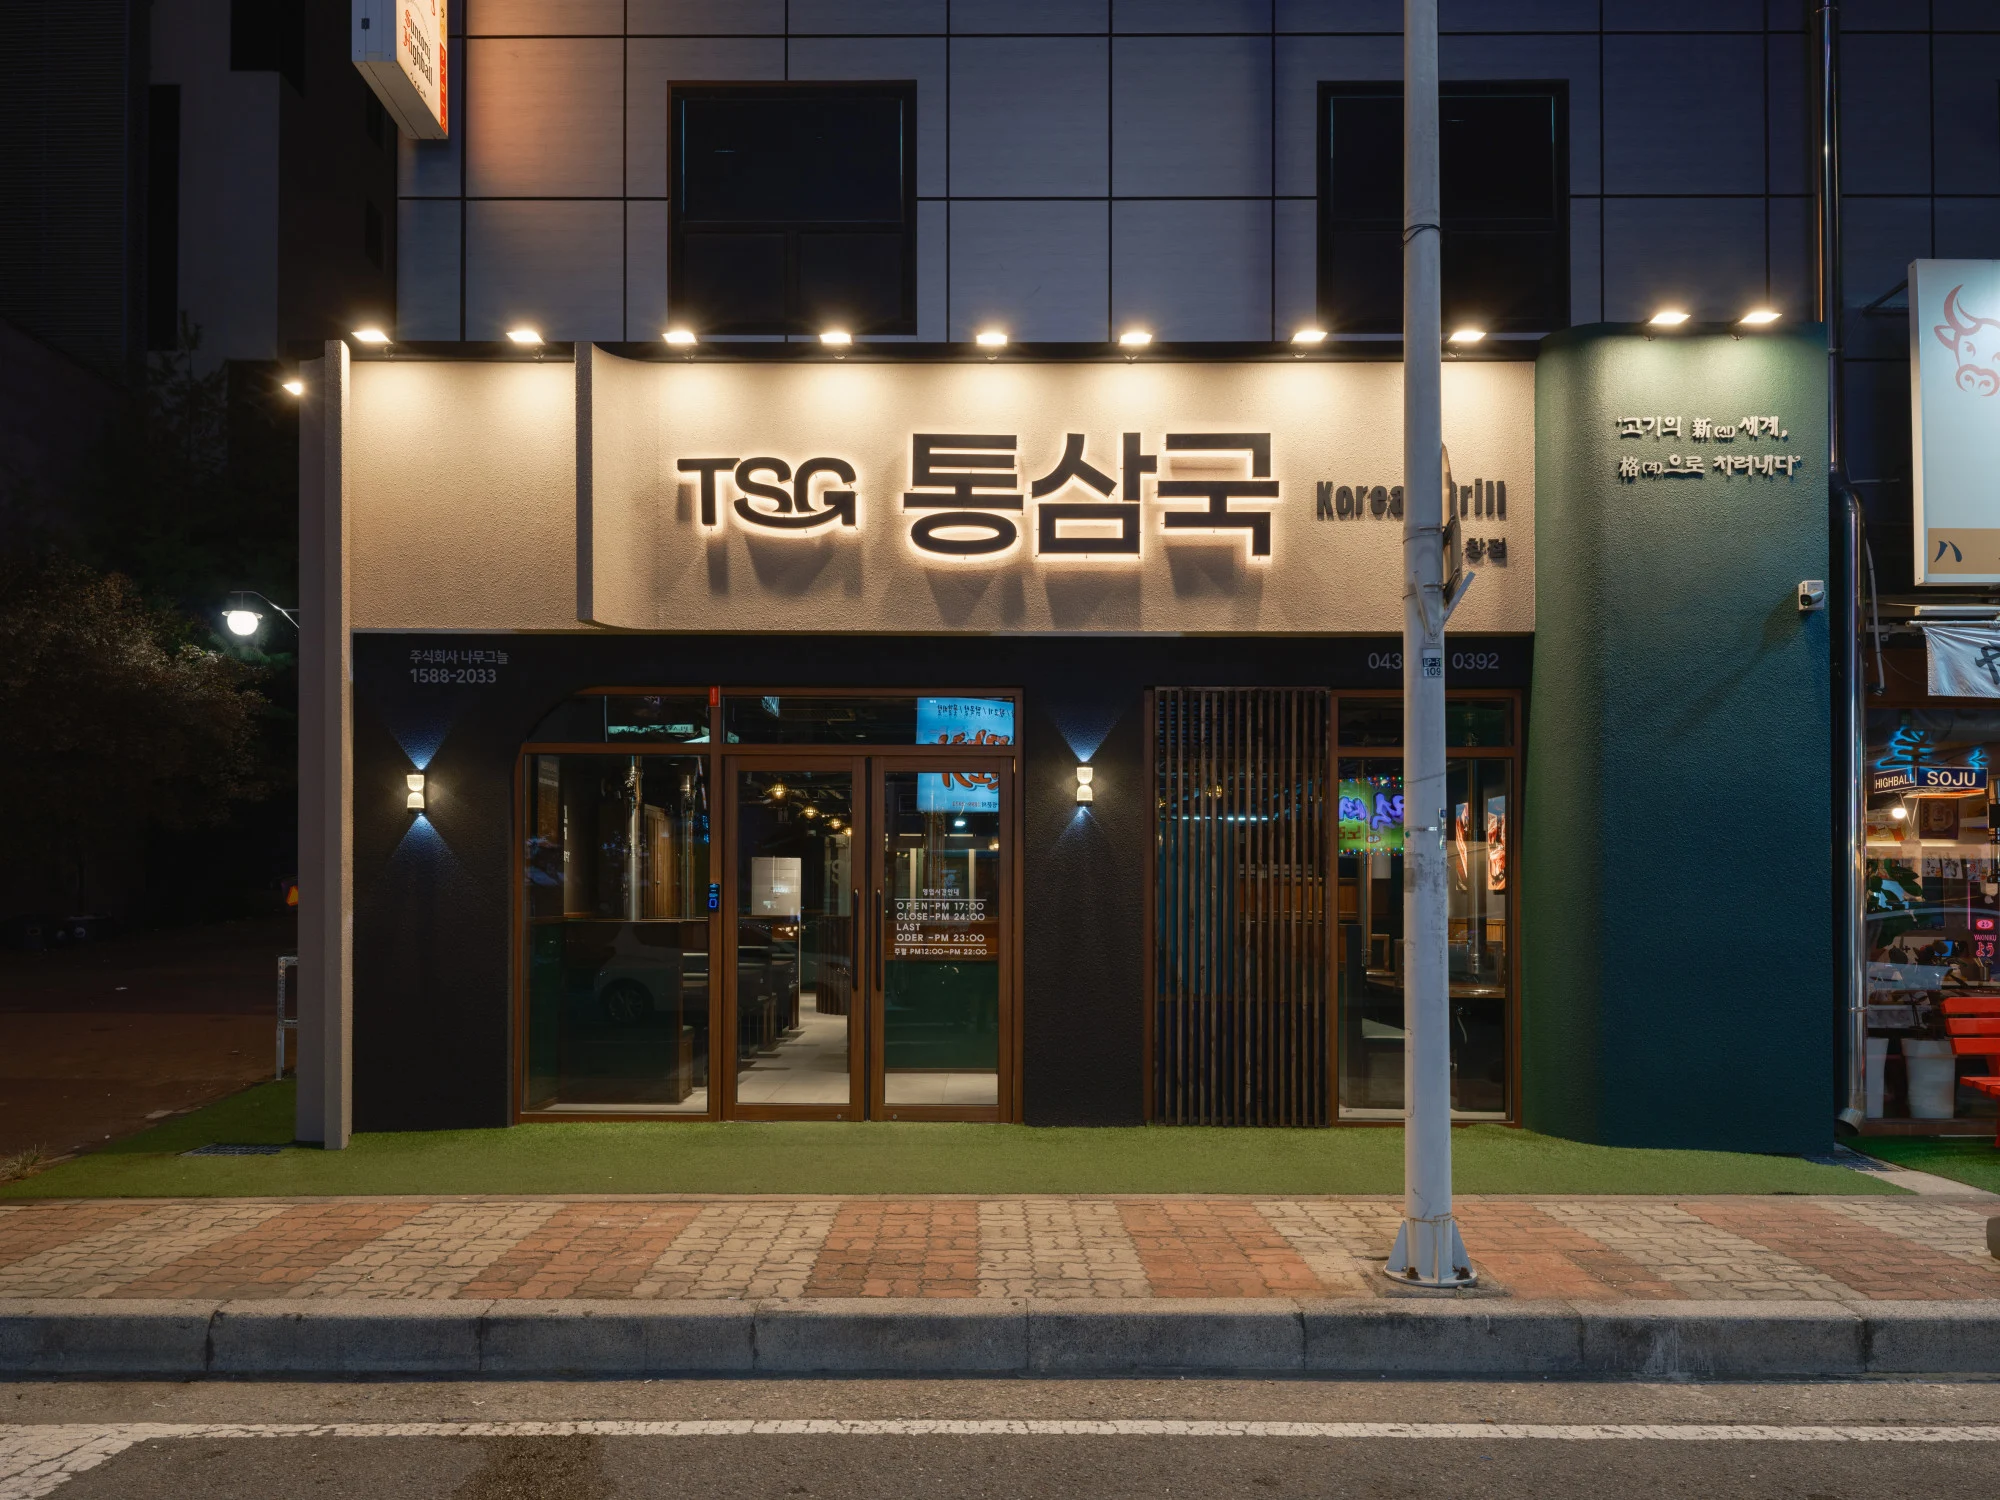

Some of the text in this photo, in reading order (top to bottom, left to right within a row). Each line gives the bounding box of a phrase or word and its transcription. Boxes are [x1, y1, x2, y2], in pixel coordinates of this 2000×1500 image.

[677, 432, 1279, 556] TSG 통삼국
[409, 649, 509, 665] 주식회사 나무그늘
[409, 668, 497, 684] 1588-2033
[1424, 667, 1441, 676] 109
[1875, 771, 1976, 789] HIGHBALL SOJU
[954, 902, 985, 910] 17:00
[953, 912, 986, 921] 24:00
[896, 923, 921, 931] LAST
[896, 933, 924, 942] ODER
[953, 933, 985, 942] 23:00
[1973, 934, 1997, 942] YAKINIKU
[963, 948, 988, 956] 22:00
[1975, 941, 1995, 957] よう
